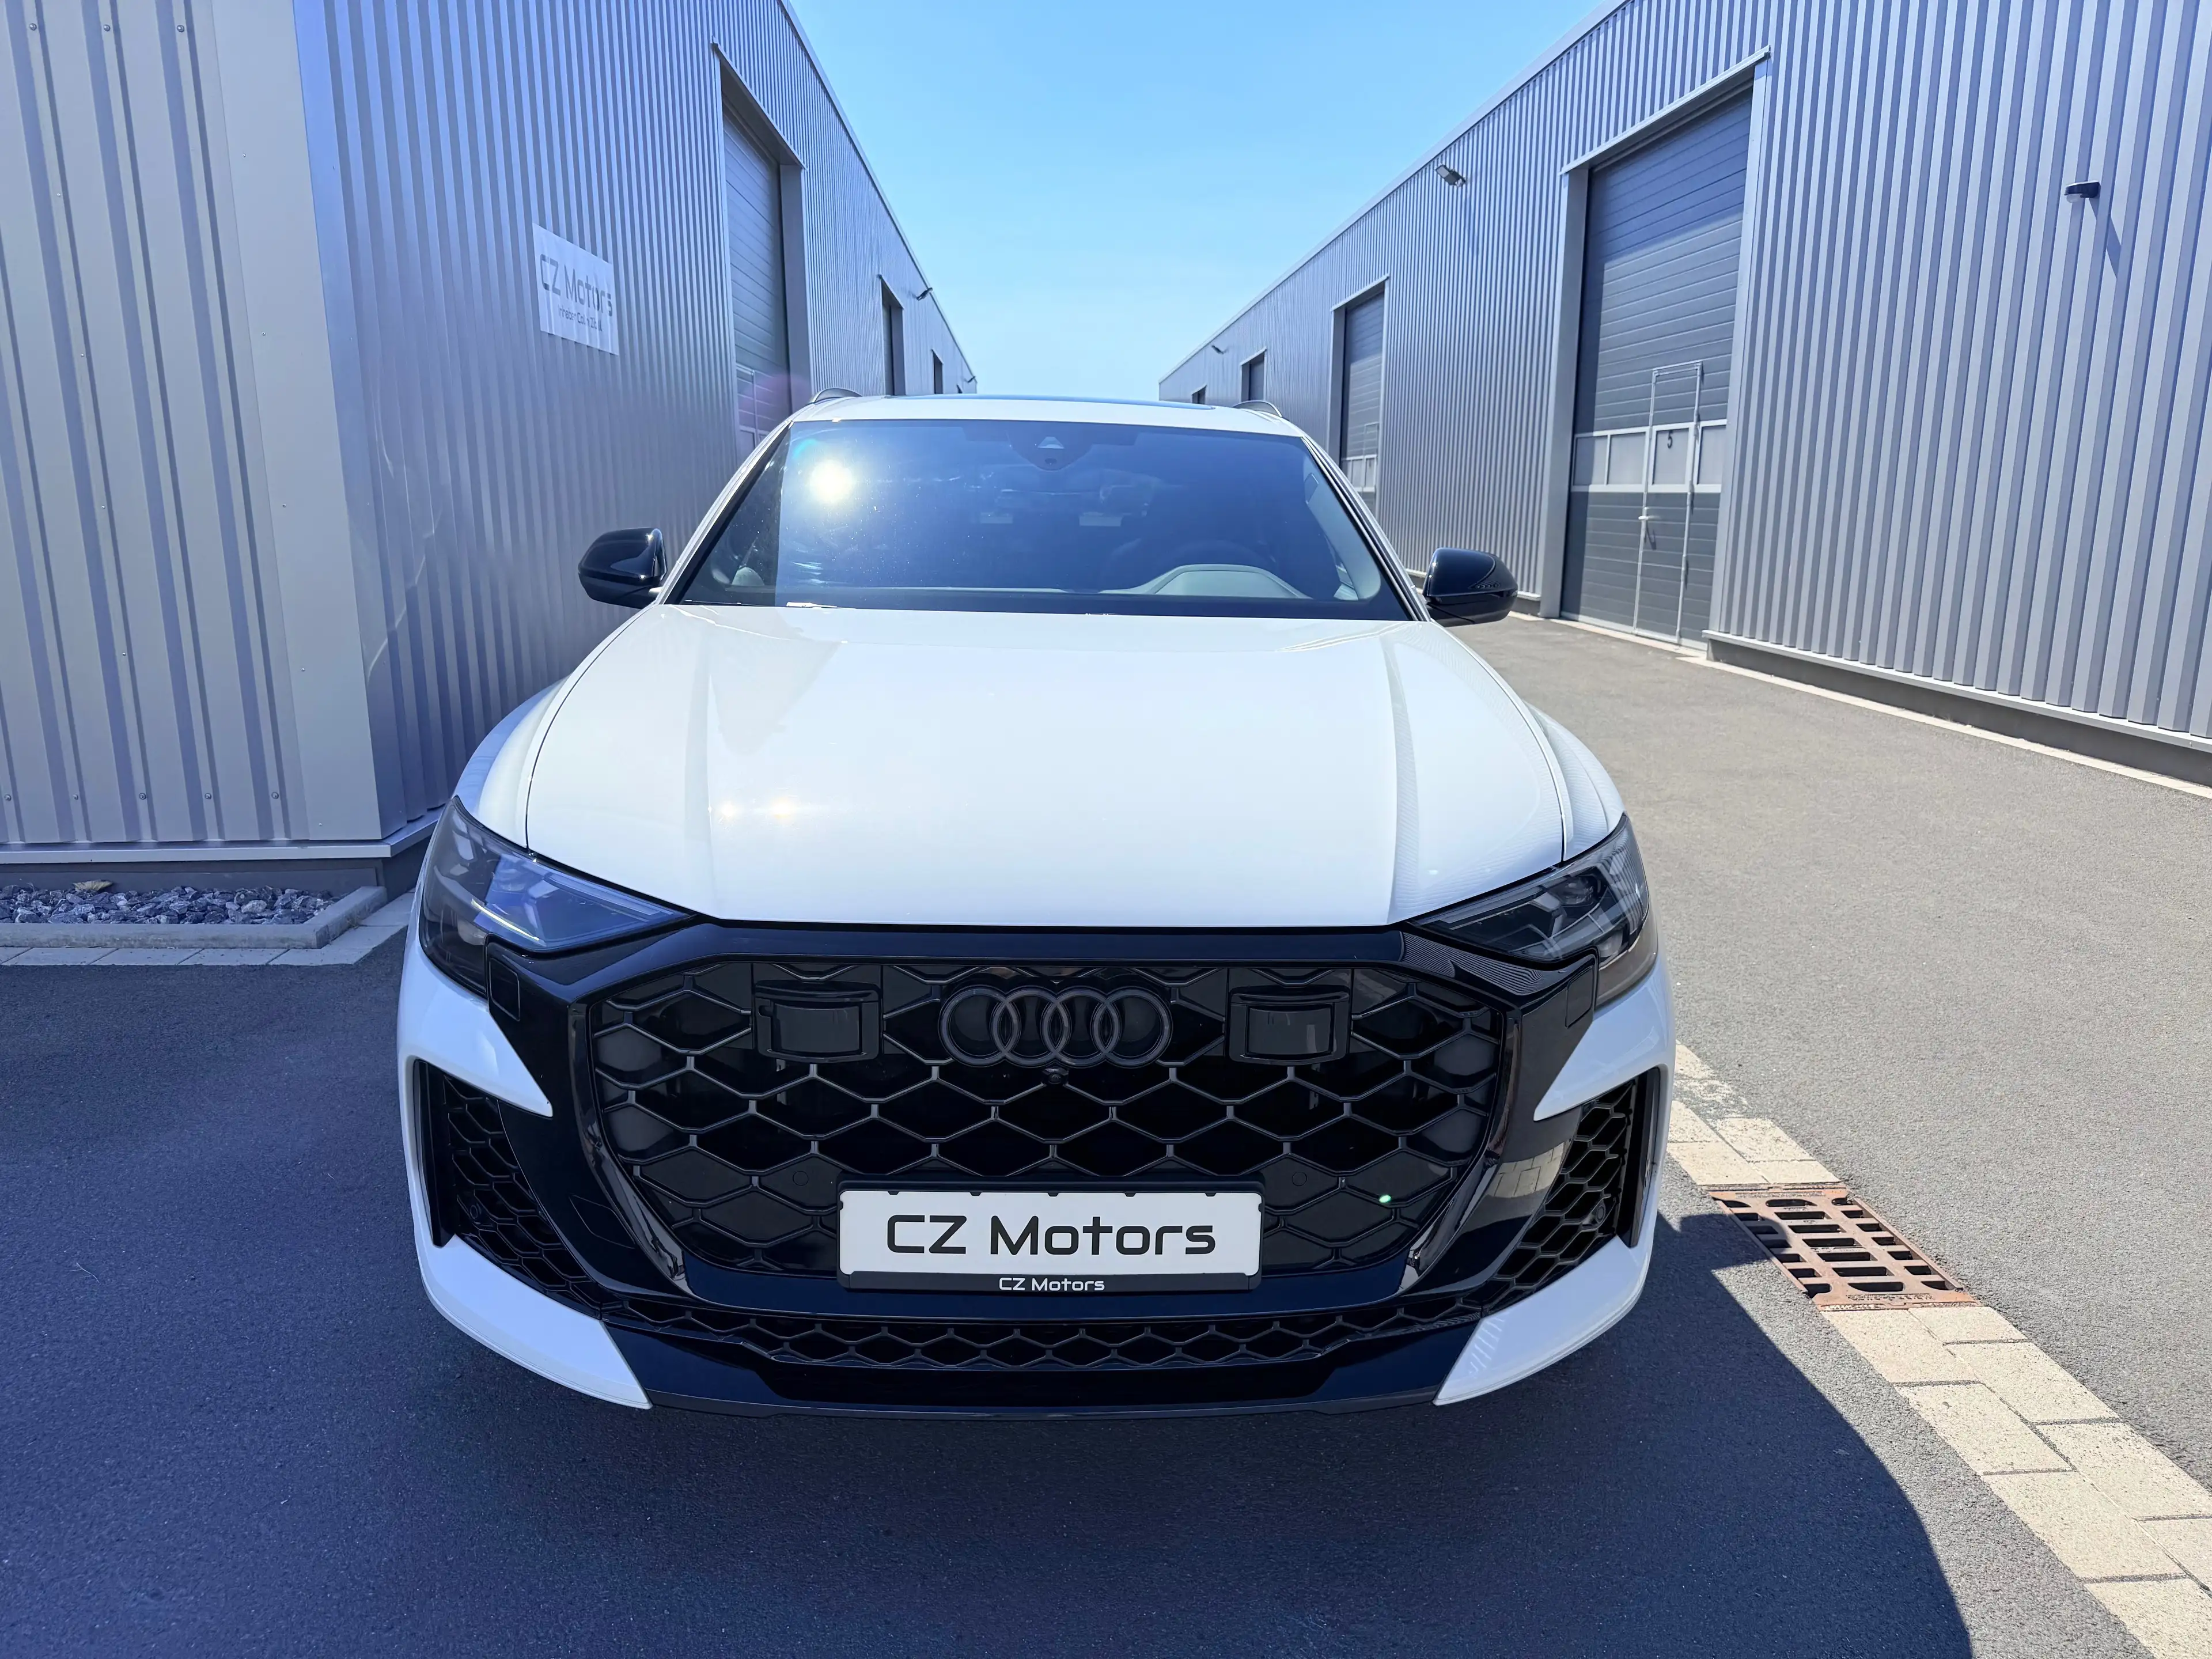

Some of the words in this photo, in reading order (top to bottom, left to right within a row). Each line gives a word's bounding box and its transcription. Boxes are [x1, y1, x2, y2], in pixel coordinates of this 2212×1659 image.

[540, 253, 561, 296] CZ
[564, 264, 613, 317] Motors
[1667, 430, 1673, 449] 5
[887, 1214, 967, 1255] CZ
[990, 1215, 1216, 1256] Motors
[999, 1277, 1025, 1291] CZ
[1031, 1278, 1105, 1291] Motors
